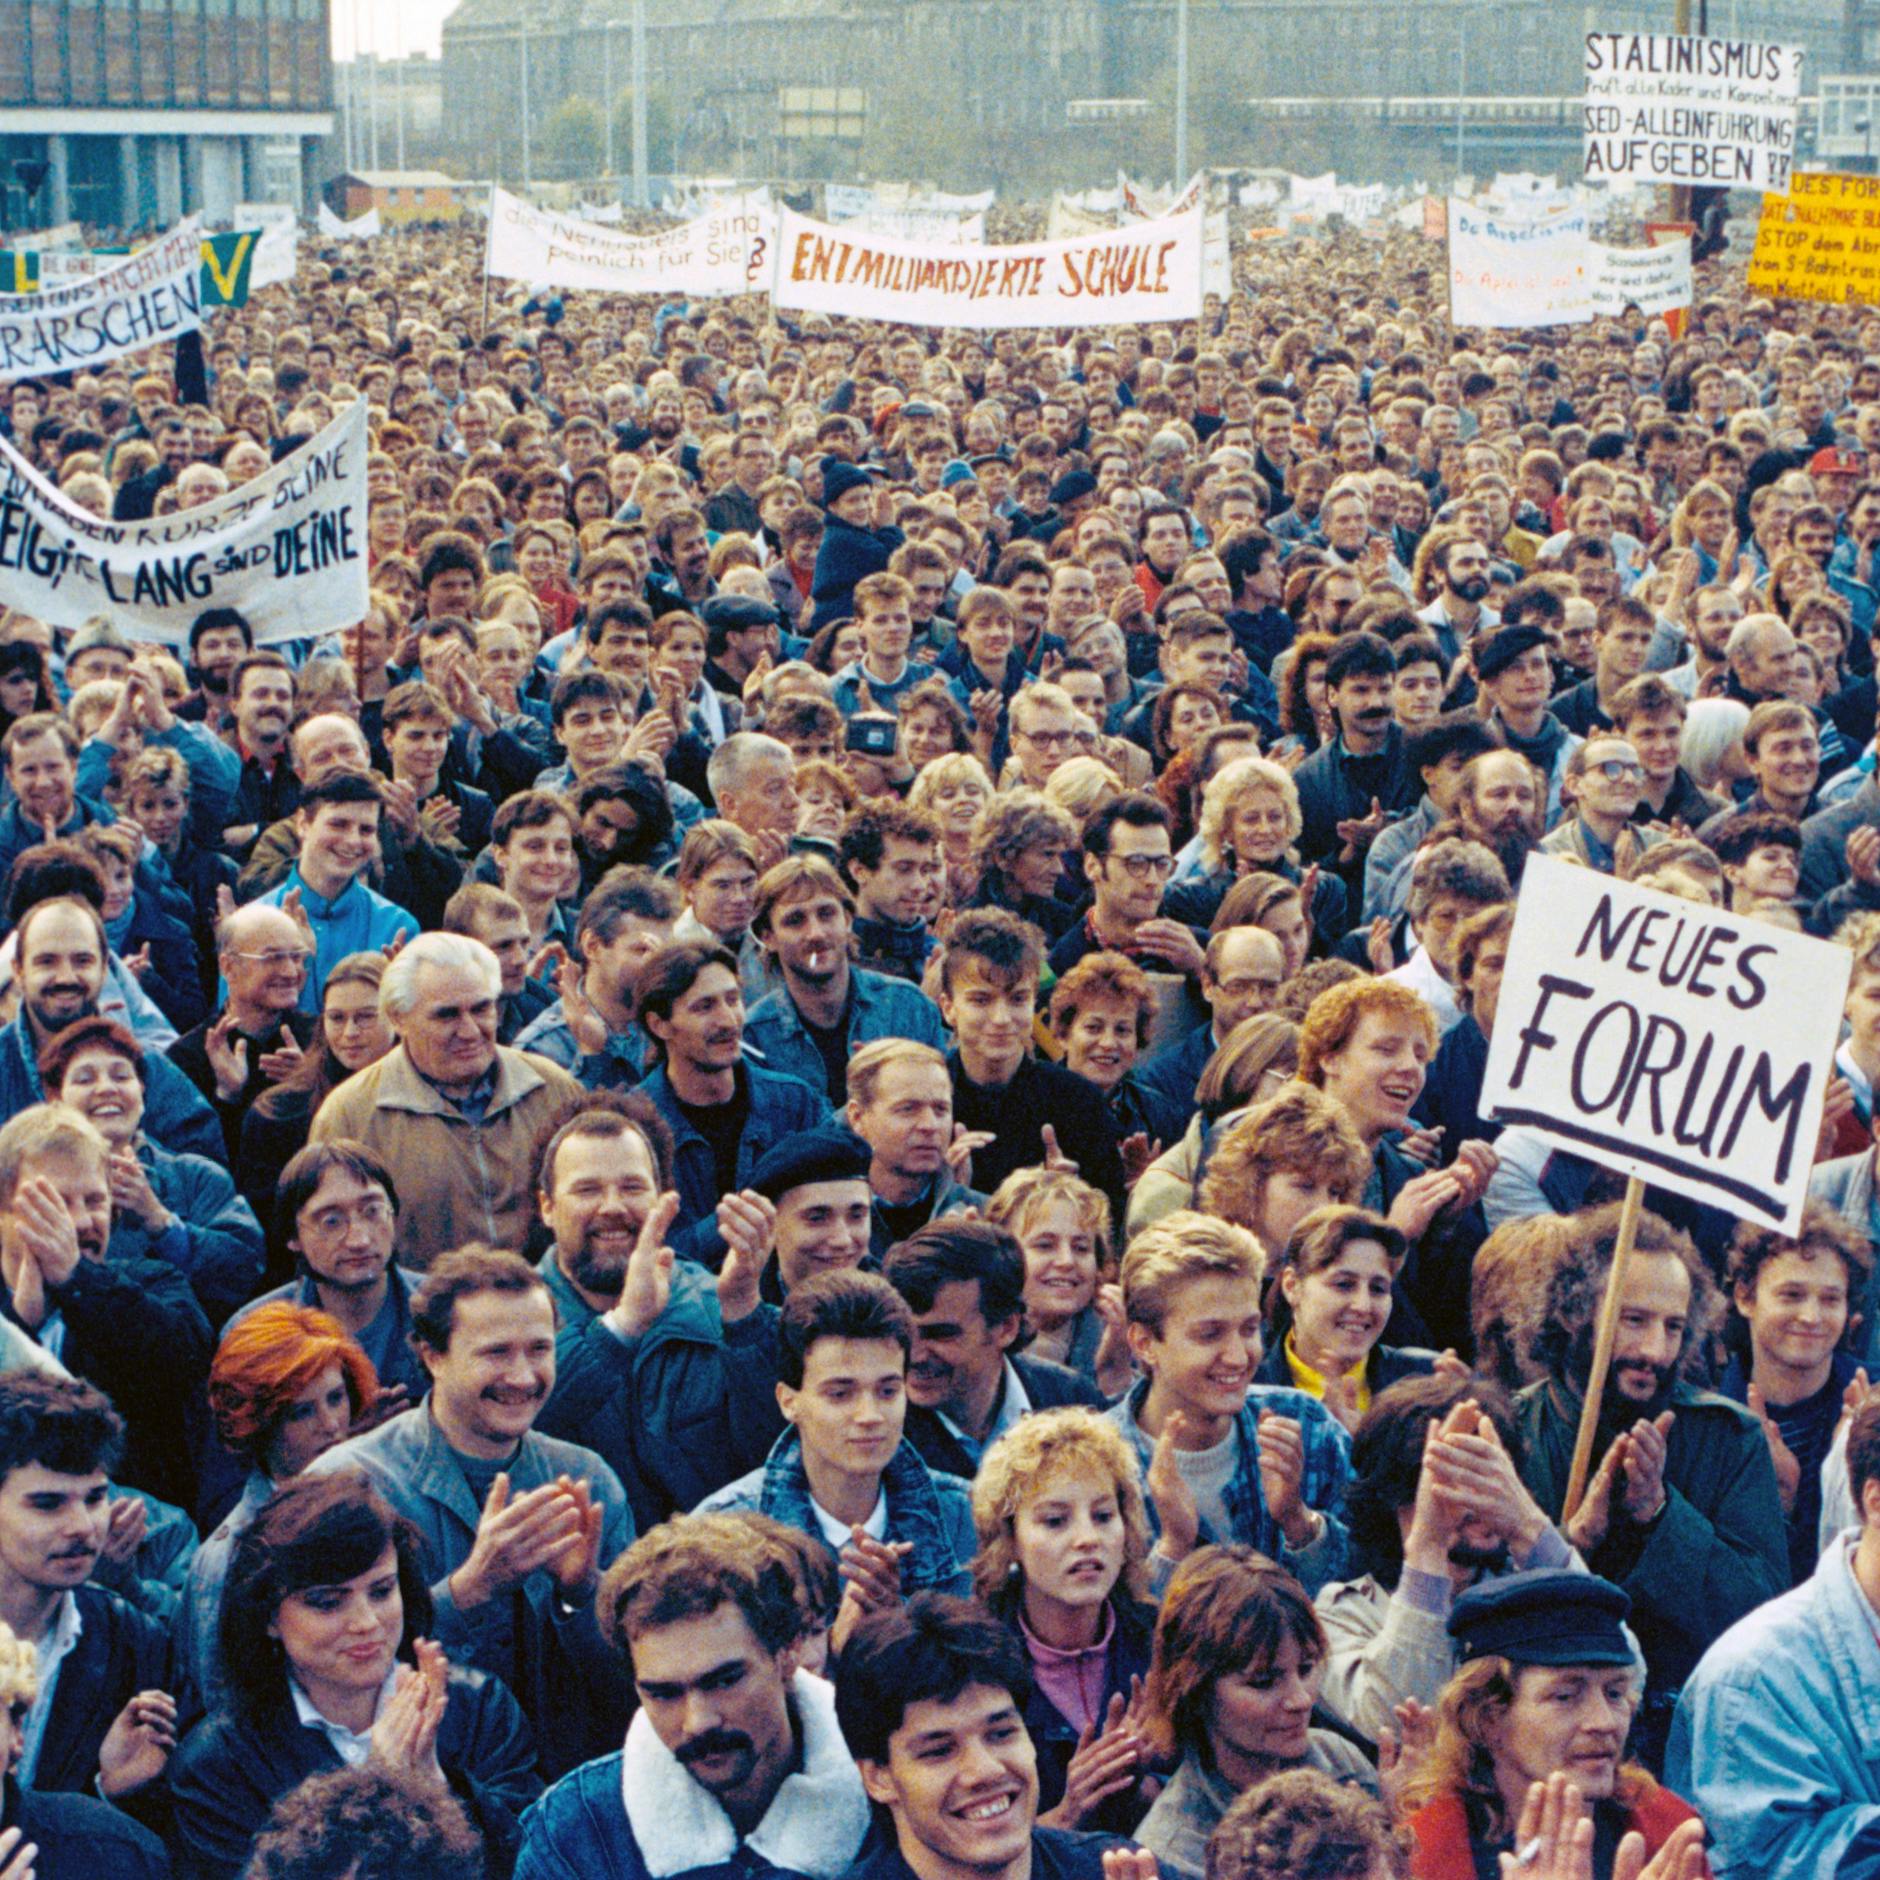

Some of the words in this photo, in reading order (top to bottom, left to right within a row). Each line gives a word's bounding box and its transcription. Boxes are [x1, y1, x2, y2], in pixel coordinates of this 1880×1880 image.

[1585, 32, 1782, 82] STALINISMUS
[1584, 139, 1754, 182] AUFGEBEN
[1791, 172, 1831, 196] UES
[1840, 175, 1880, 199] FOR
[707, 211, 760, 241] sind
[1760, 228, 1809, 249] STOP
[1851, 235, 1880, 255] Abr
[98, 251, 161, 297] NICHT
[658, 249, 693, 274] für
[705, 240, 742, 267] Sie
[1057, 240, 1178, 298] SCHULE
[1786, 254, 1880, 279] S-Bahntras
[0, 272, 200, 371] RARSCHEN
[100, 552, 213, 608] LANG
[1574, 893, 1779, 1010] NEUES
[1507, 973, 1813, 1186] FORUM
